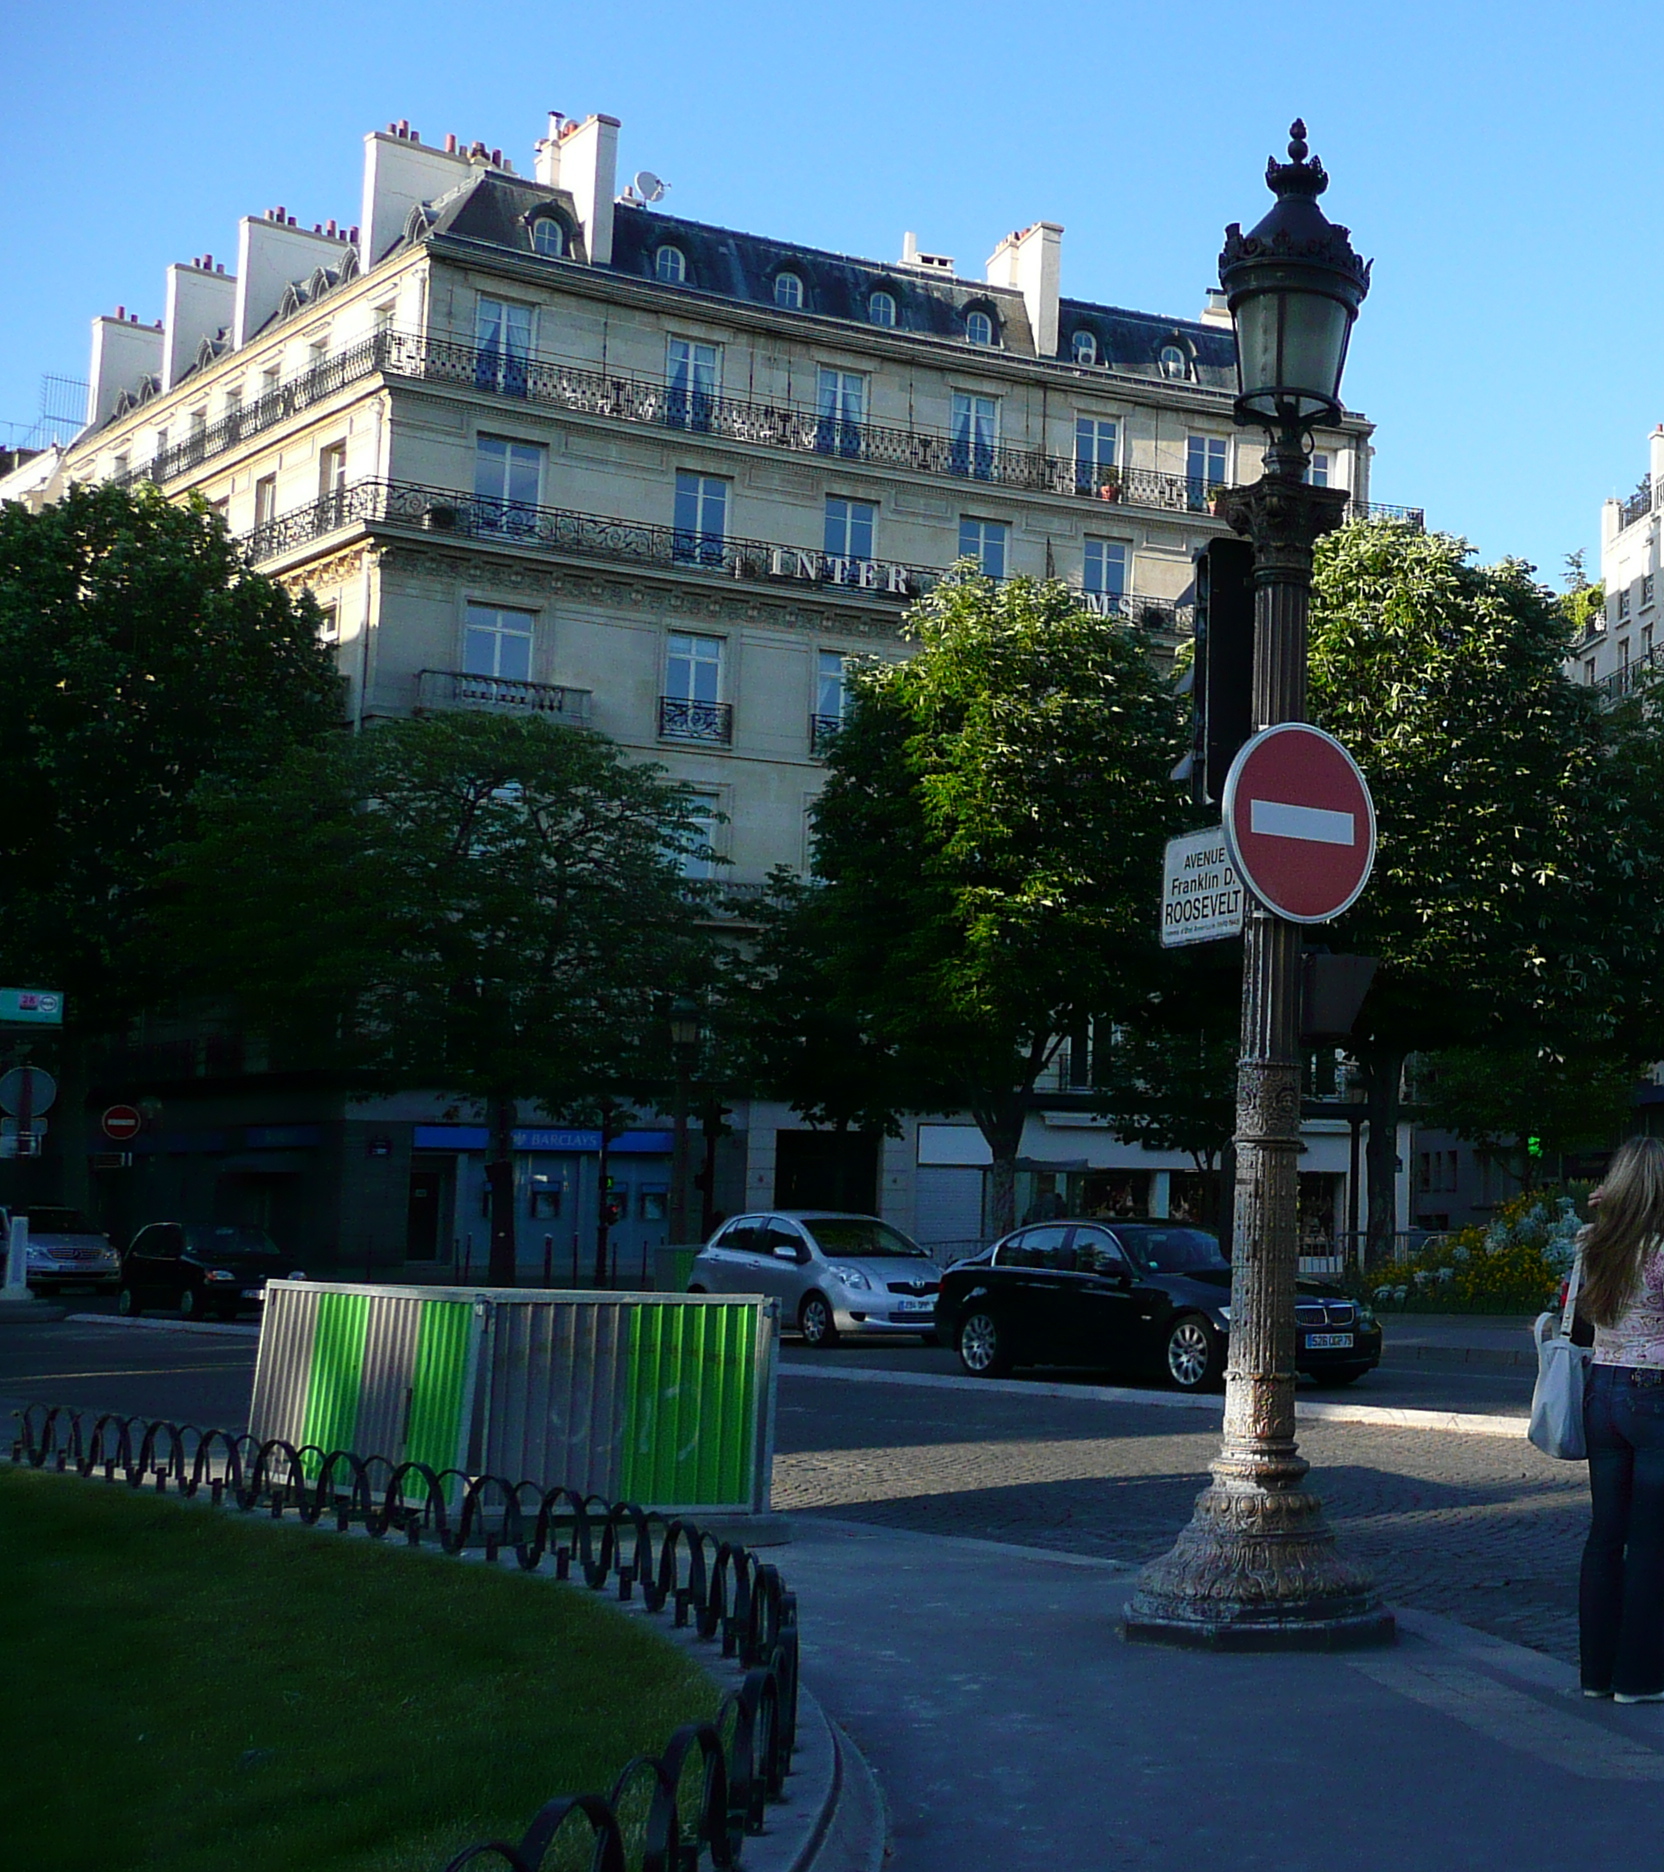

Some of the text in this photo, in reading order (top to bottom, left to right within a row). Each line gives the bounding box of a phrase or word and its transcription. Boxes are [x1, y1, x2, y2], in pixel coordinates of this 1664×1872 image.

[769, 547, 909, 595] INTER
[1184, 847, 1226, 870] AVENUE
[1171, 867, 1236, 896] Franklin D.
[1165, 889, 1241, 926] ROOSEVELT
[532, 1133, 597, 1147] BARCLAYS
